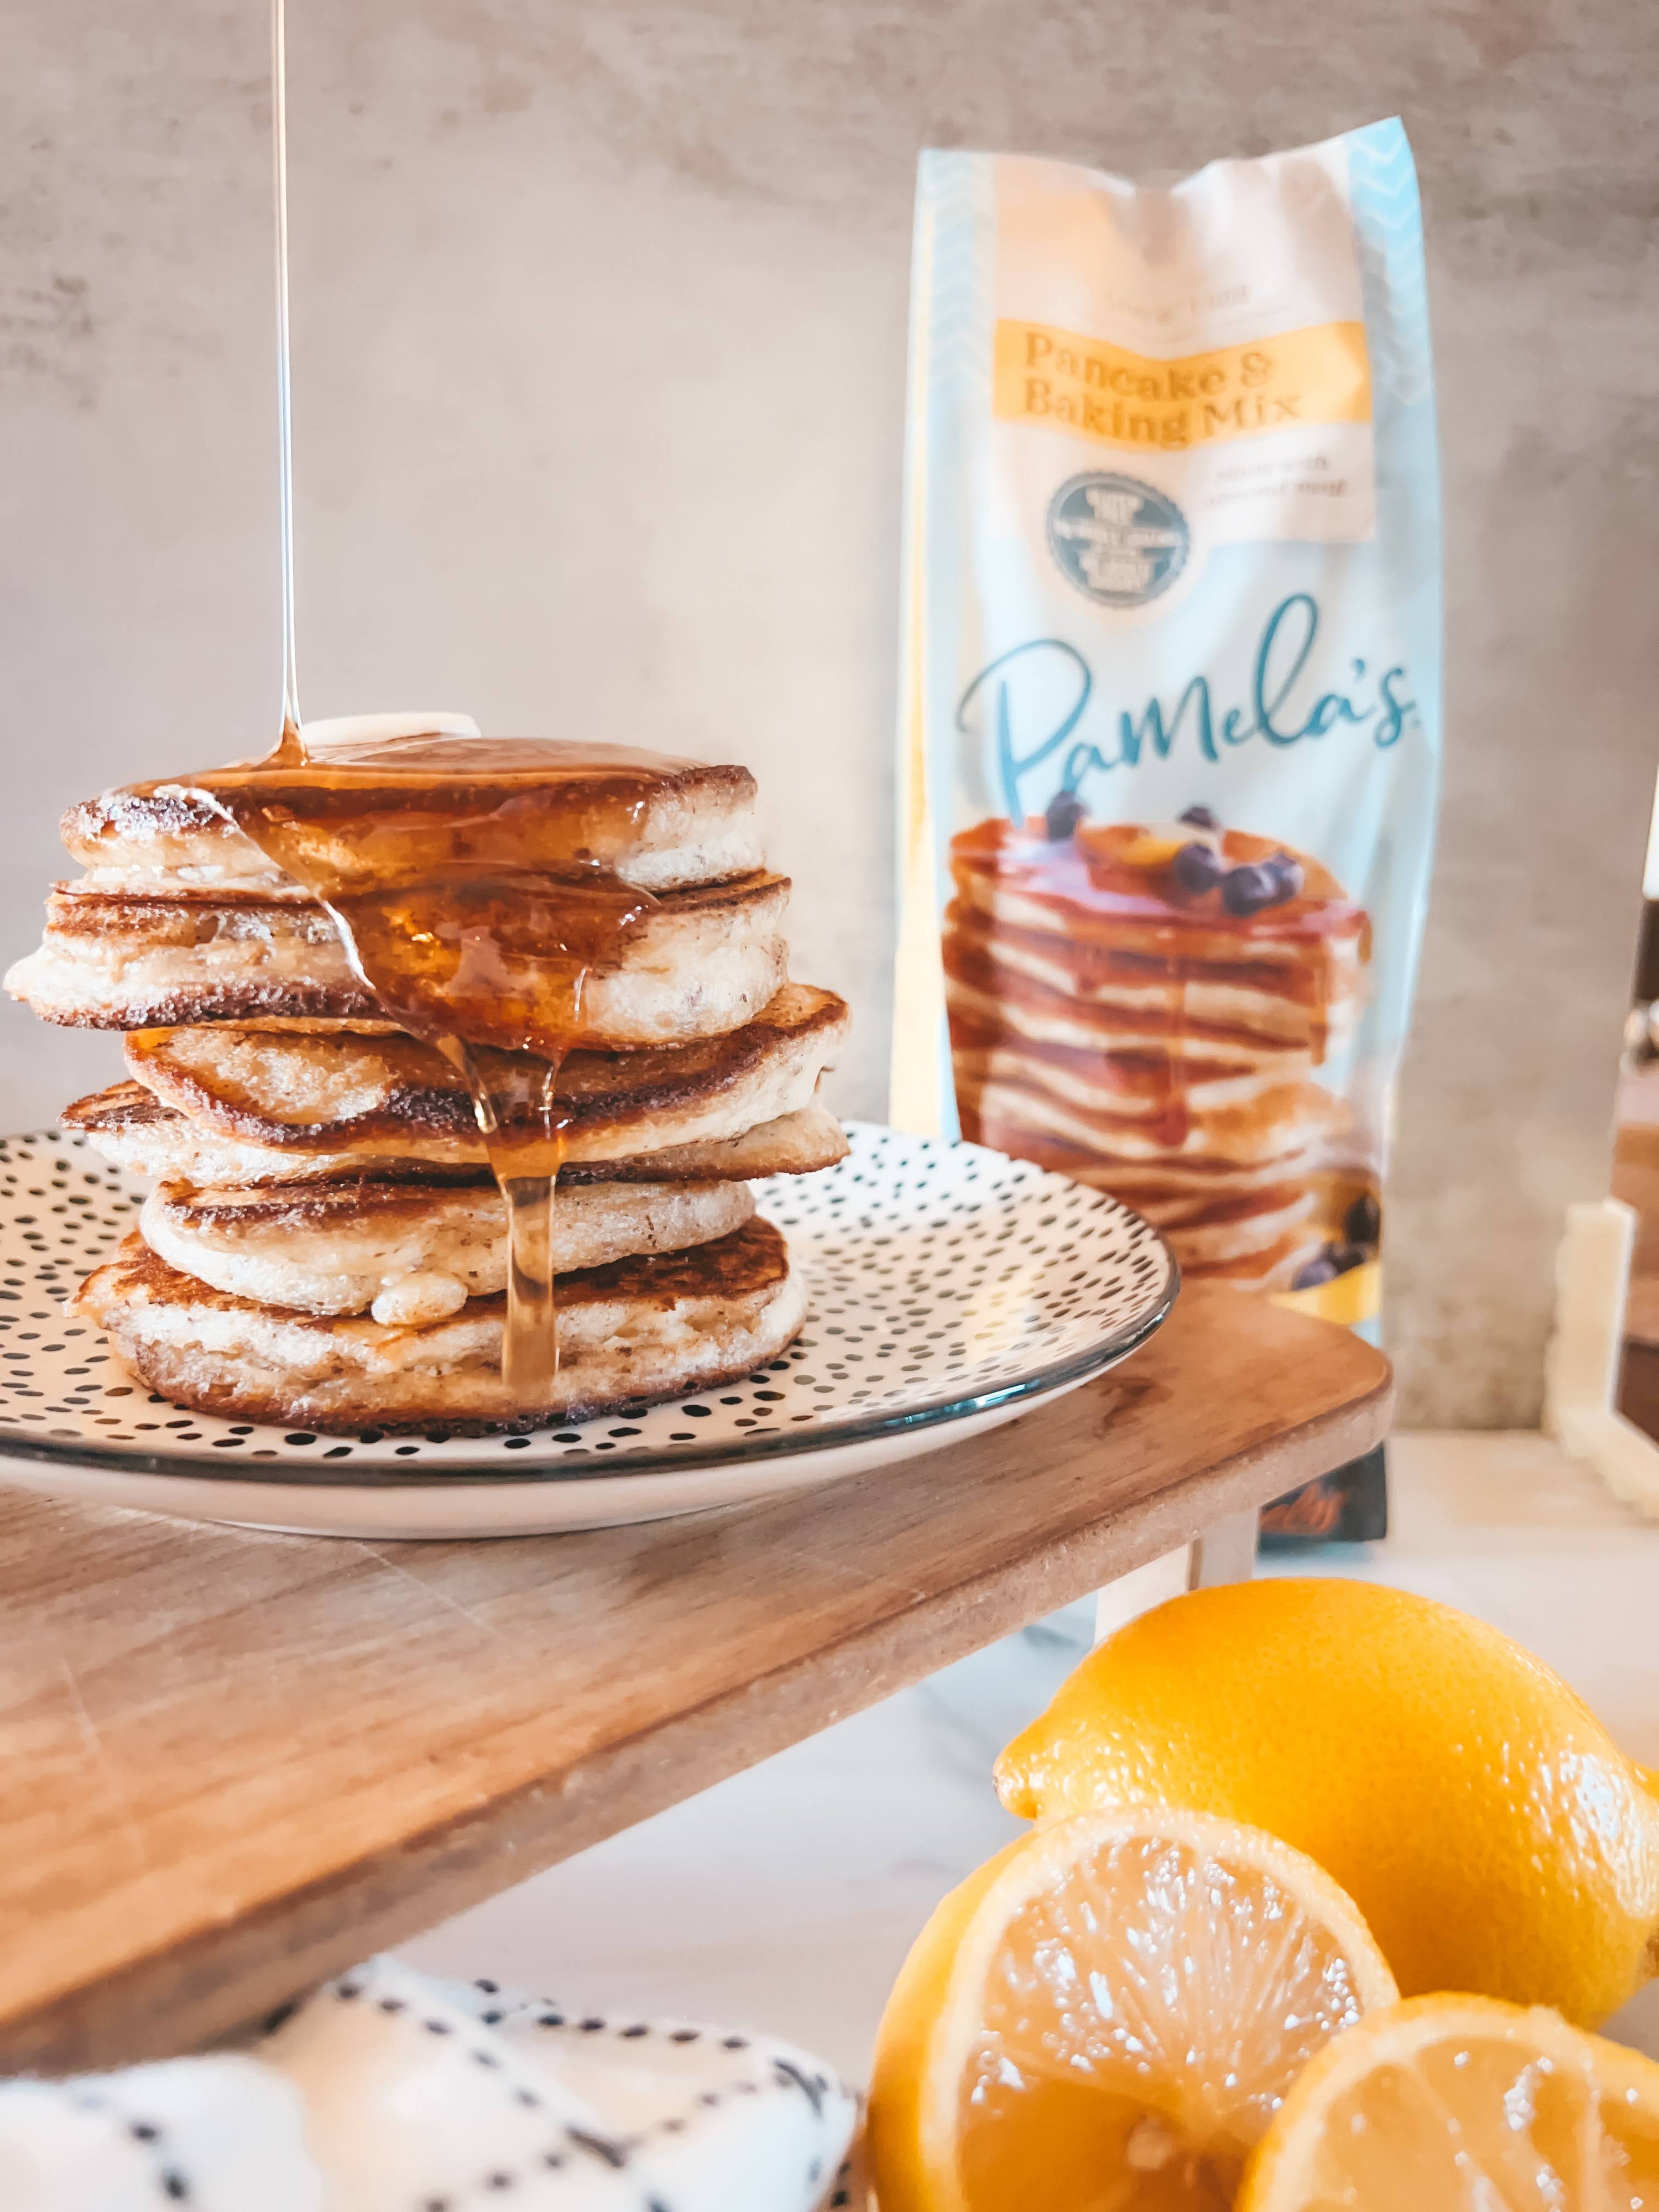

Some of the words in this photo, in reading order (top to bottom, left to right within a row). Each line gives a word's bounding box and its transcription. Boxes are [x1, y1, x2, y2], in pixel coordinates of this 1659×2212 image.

[1025, 331, 1226, 401] Pancake
[1240, 351, 1274, 388] &
[1025, 378, 1190, 452] Baking
[1202, 393, 1302, 436] Mix
